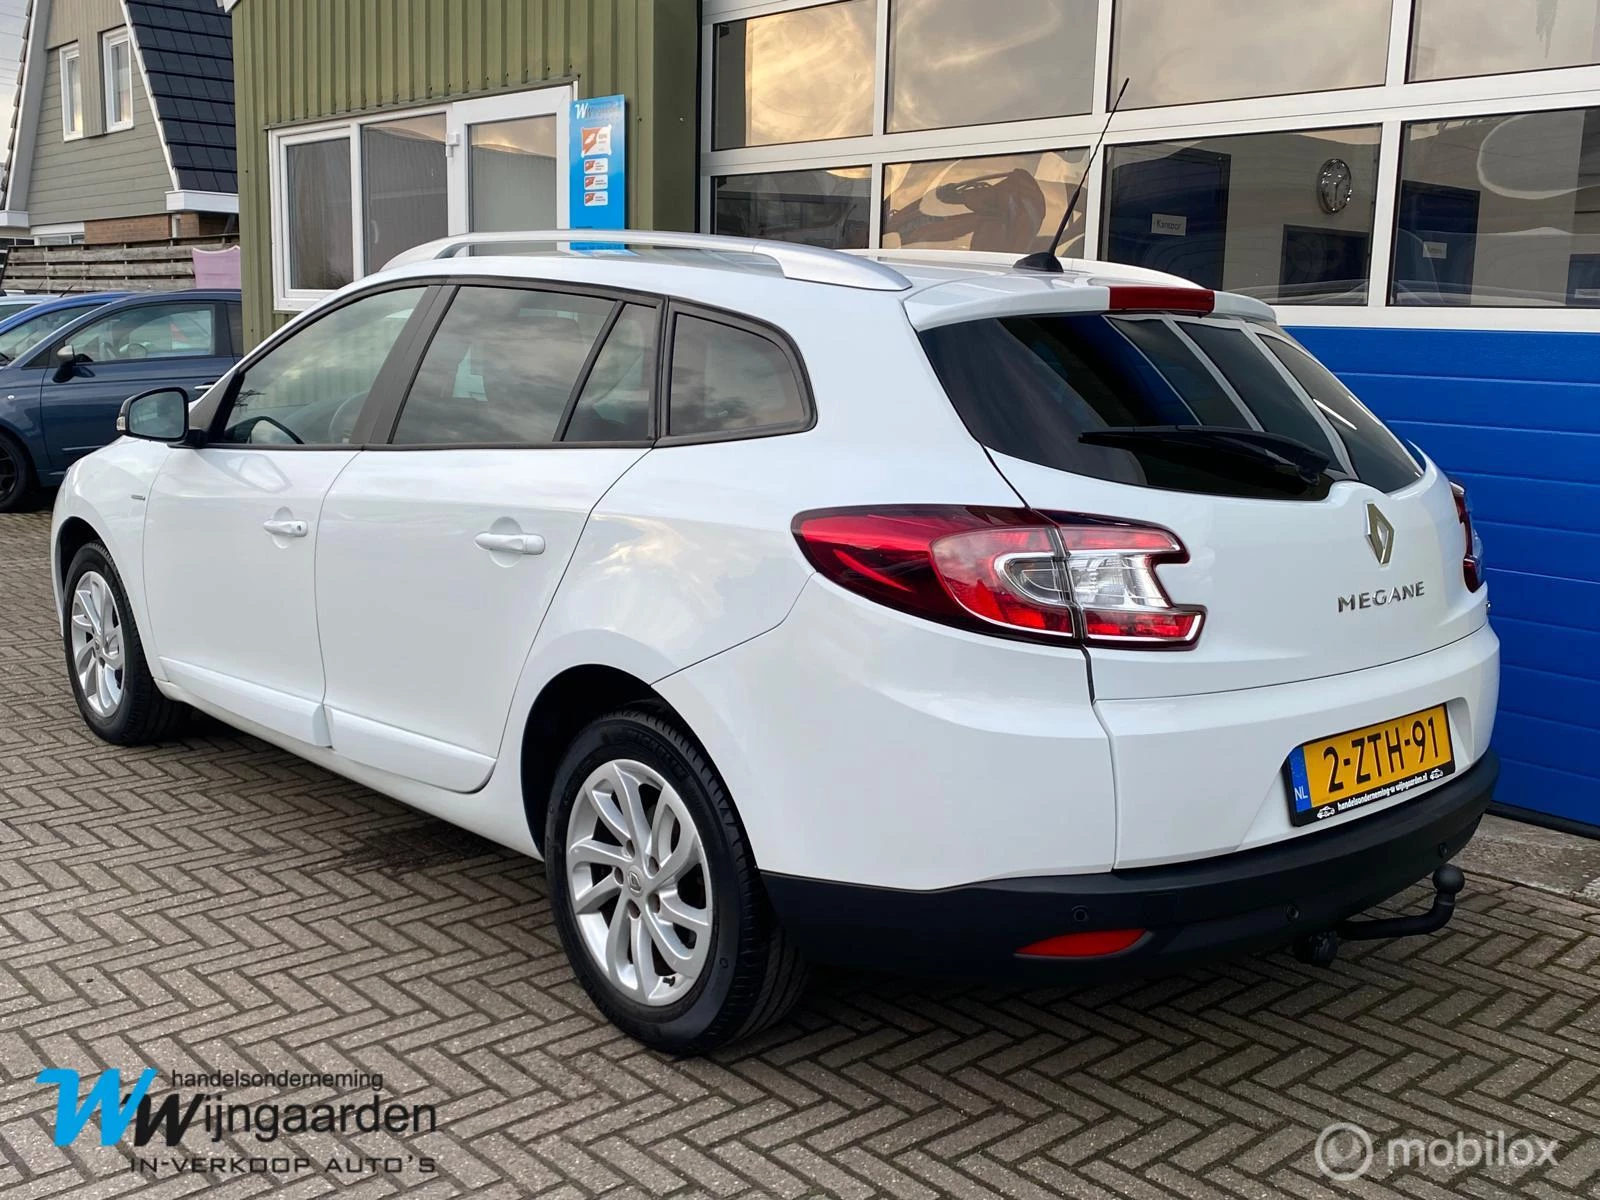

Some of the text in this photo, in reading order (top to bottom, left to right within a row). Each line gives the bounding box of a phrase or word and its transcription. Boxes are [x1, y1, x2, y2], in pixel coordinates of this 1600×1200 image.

[1337, 581, 1425, 613] MEGANE
[1323, 717, 1439, 793] 2-ZTH-91
[1294, 785, 1308, 800] NL
